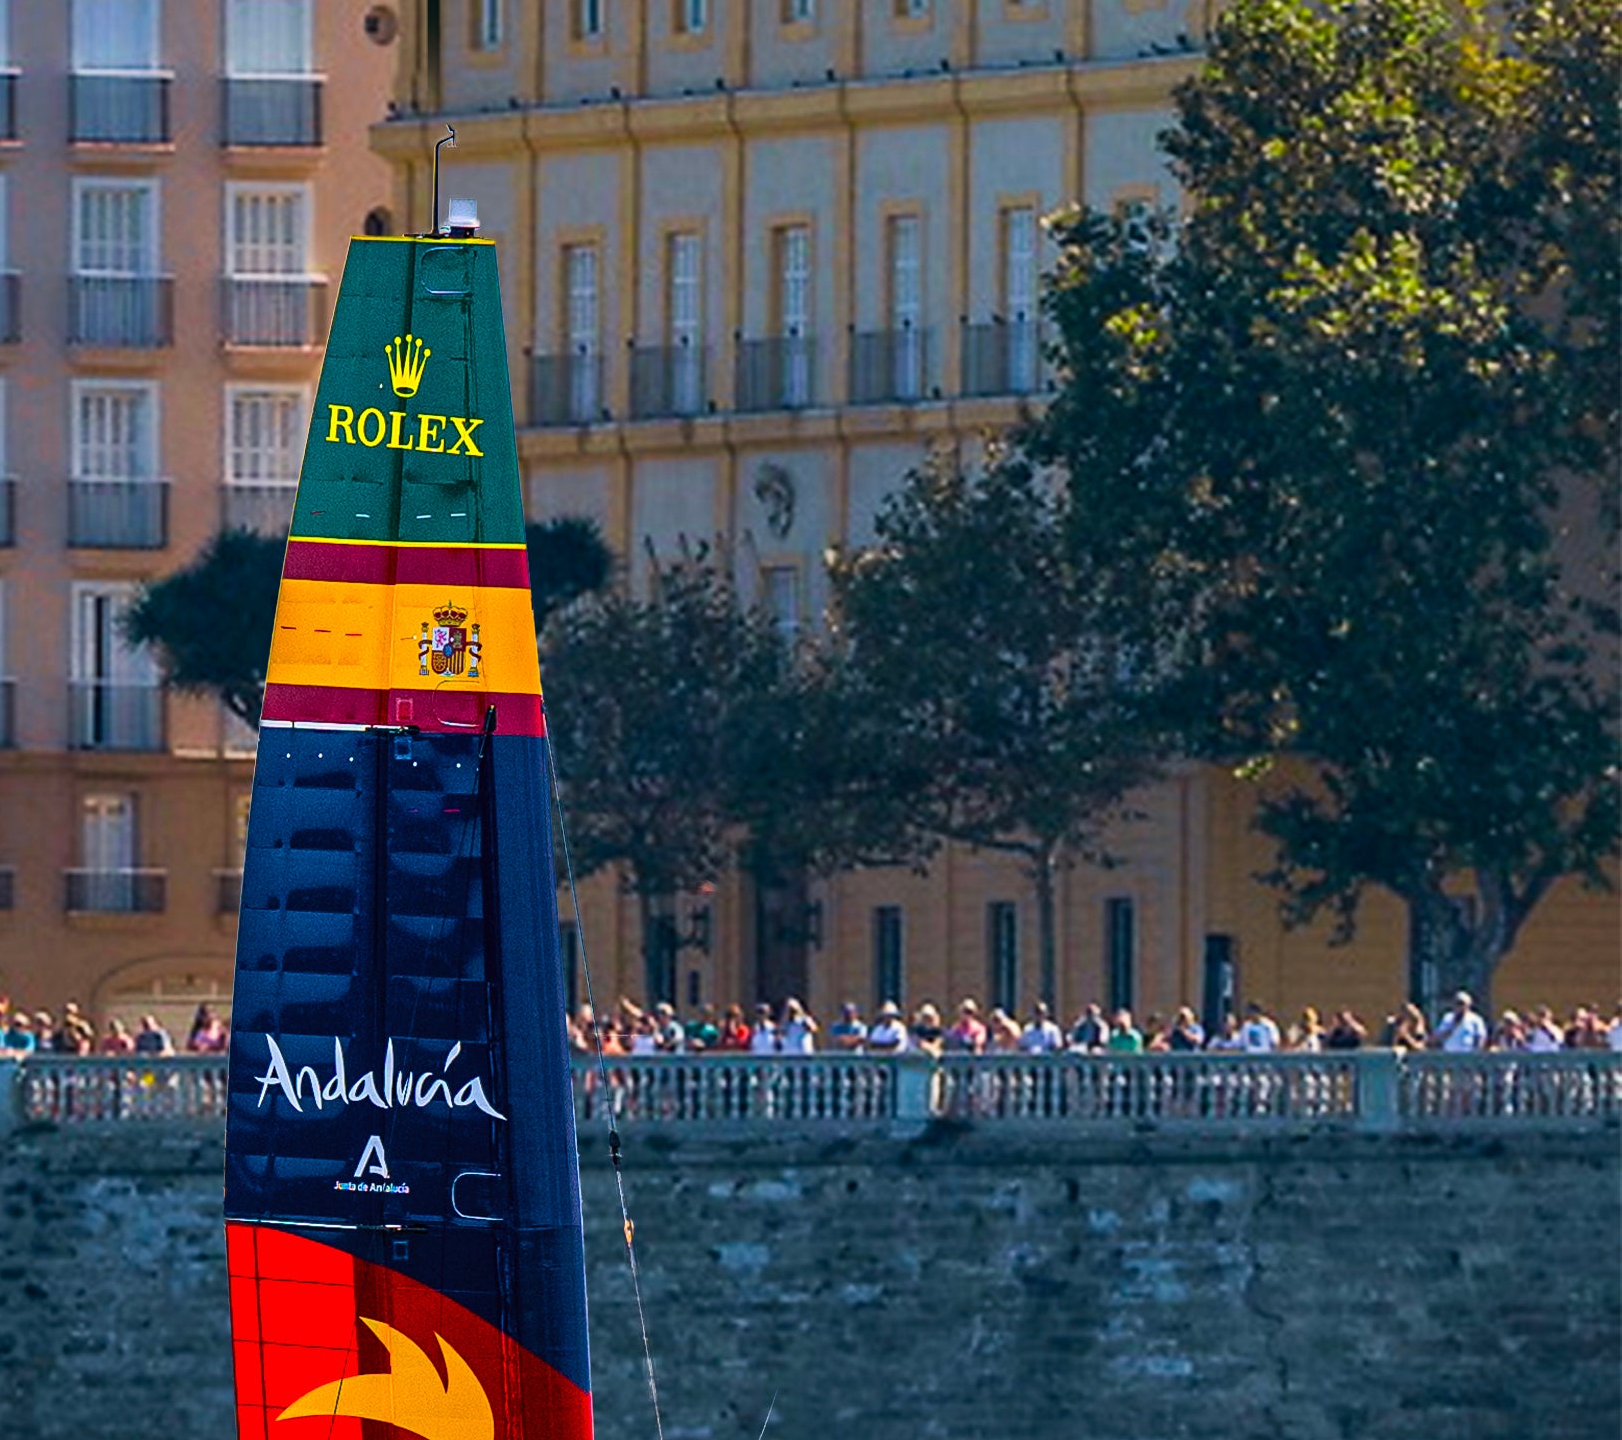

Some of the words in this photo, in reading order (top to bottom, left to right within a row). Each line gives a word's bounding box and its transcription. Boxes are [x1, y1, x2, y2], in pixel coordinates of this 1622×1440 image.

[326, 404, 484, 457] ROLEX
[254, 1034, 507, 1120] Andalucía
[357, 1181, 368, 1191] de
